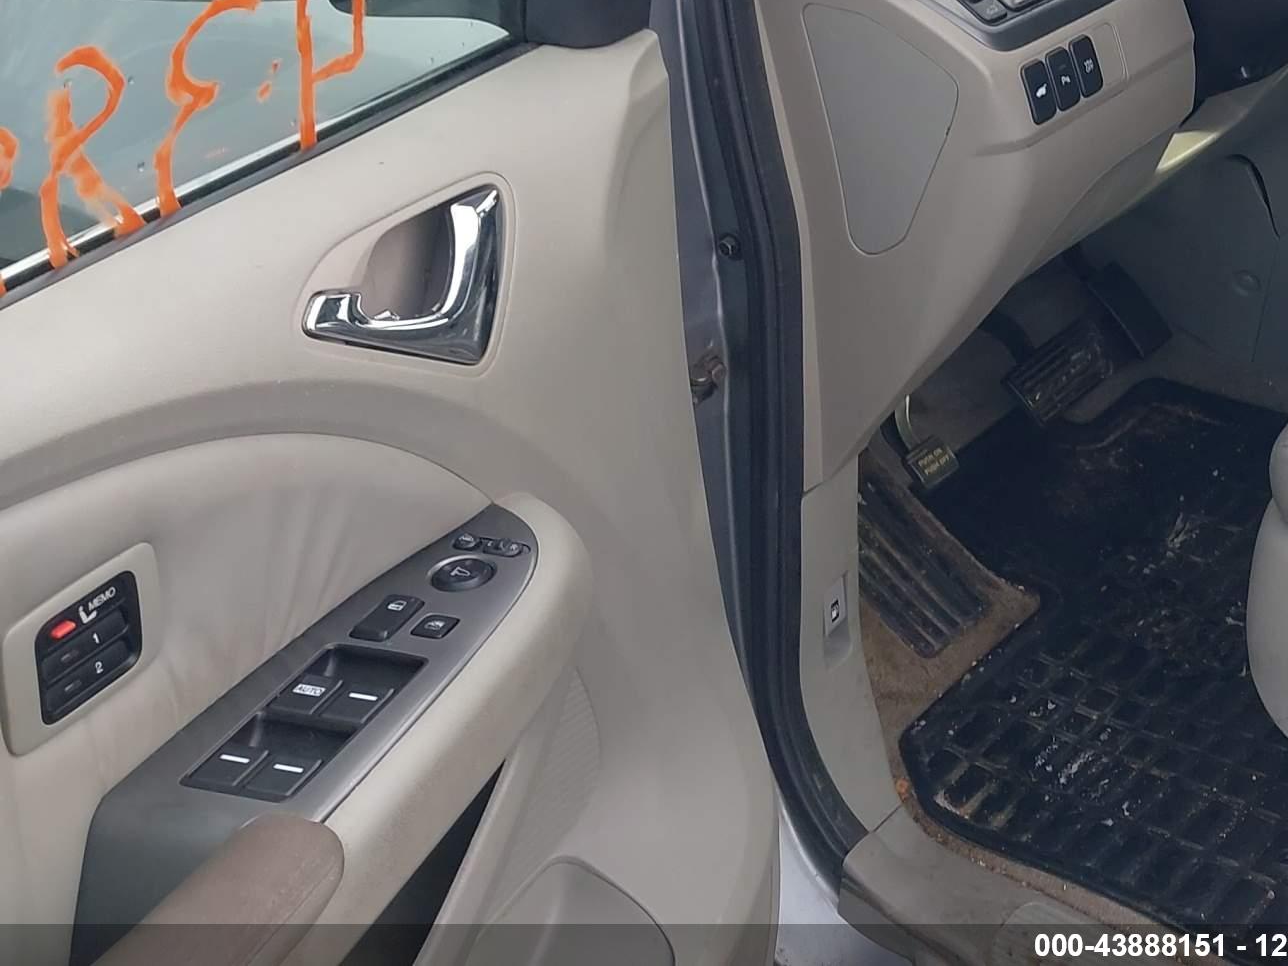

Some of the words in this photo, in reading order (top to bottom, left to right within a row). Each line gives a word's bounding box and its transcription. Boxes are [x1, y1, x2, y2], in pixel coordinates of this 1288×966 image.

[88, 586, 117, 611] MEMO
[93, 632, 100, 644] 1
[95, 661, 103, 674] 2
[295, 684, 325, 696] AUTO
